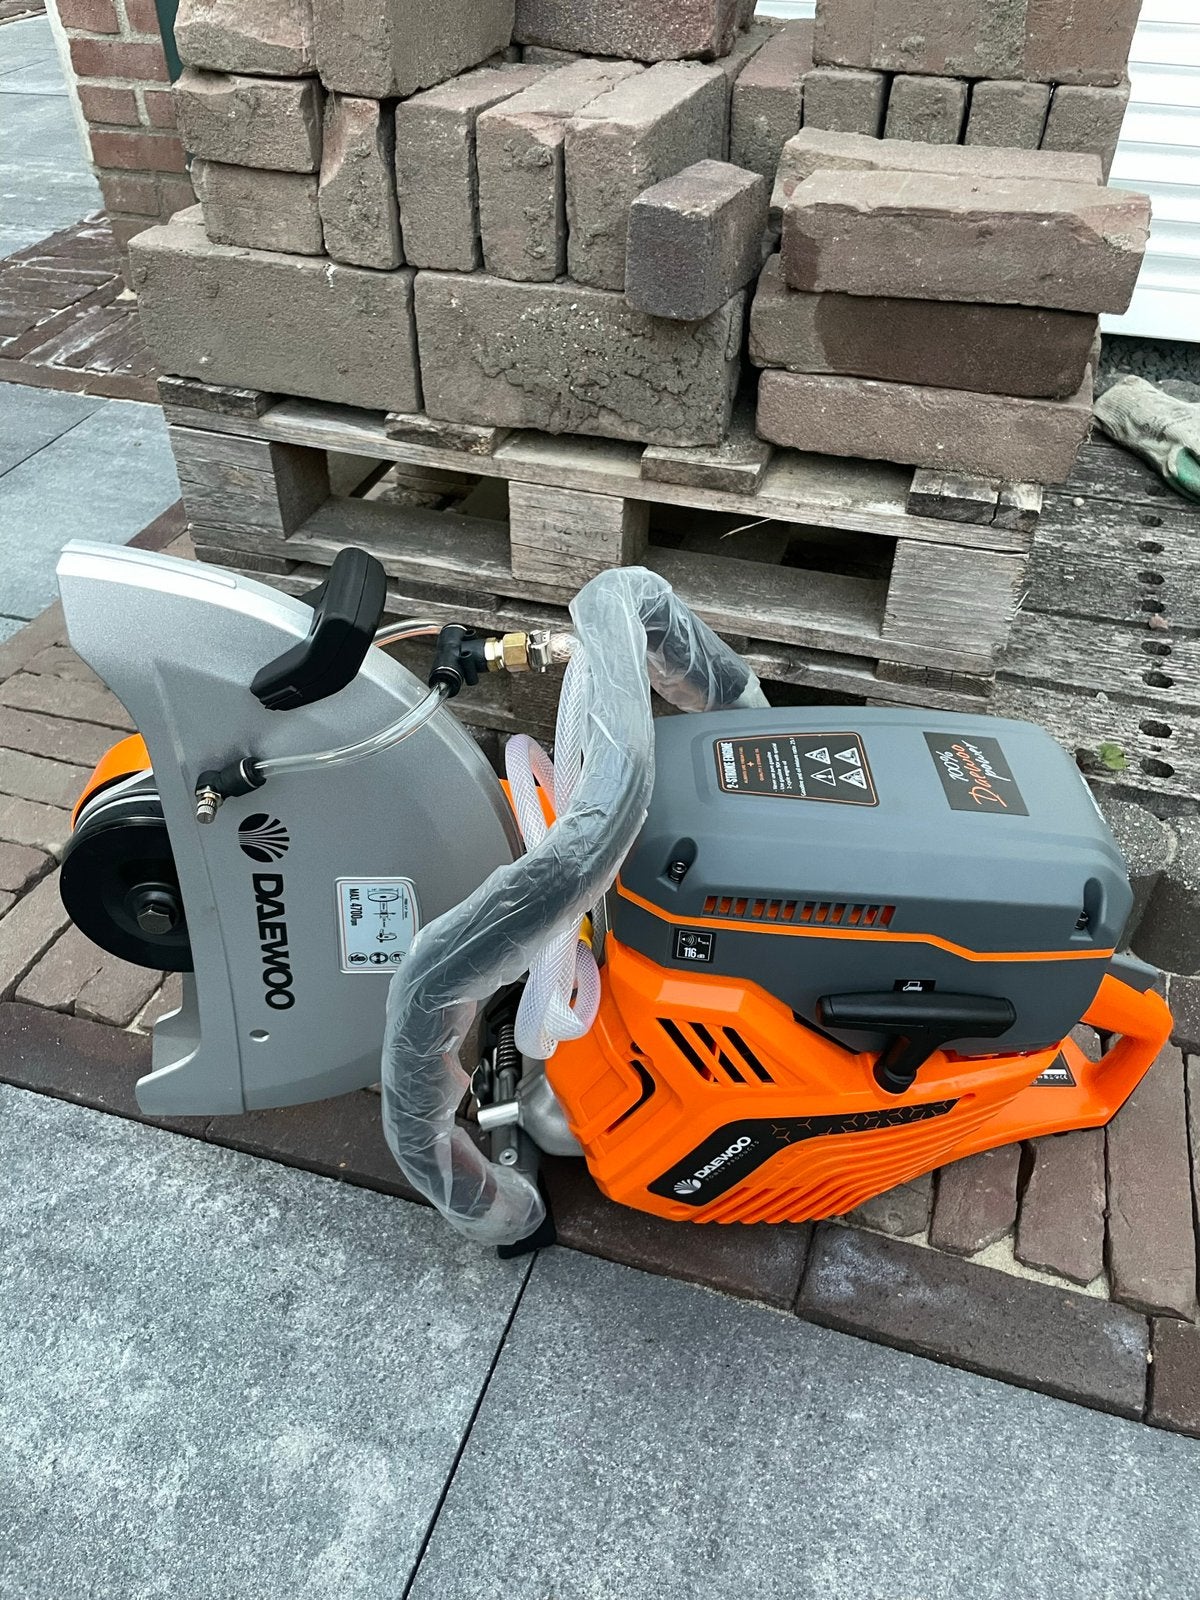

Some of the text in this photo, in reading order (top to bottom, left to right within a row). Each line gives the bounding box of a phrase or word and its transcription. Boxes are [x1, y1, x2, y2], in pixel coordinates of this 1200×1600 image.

[721, 742, 738, 788] 2-STROKE ENGINE
[936, 750, 969, 782] 100%
[951, 744, 1007, 808] Daewoo
[961, 740, 1012, 782] power
[252, 873, 295, 1010] DAEWOO
[684, 947, 697, 958] 116
[693, 1136, 752, 1178] DAEWOO
